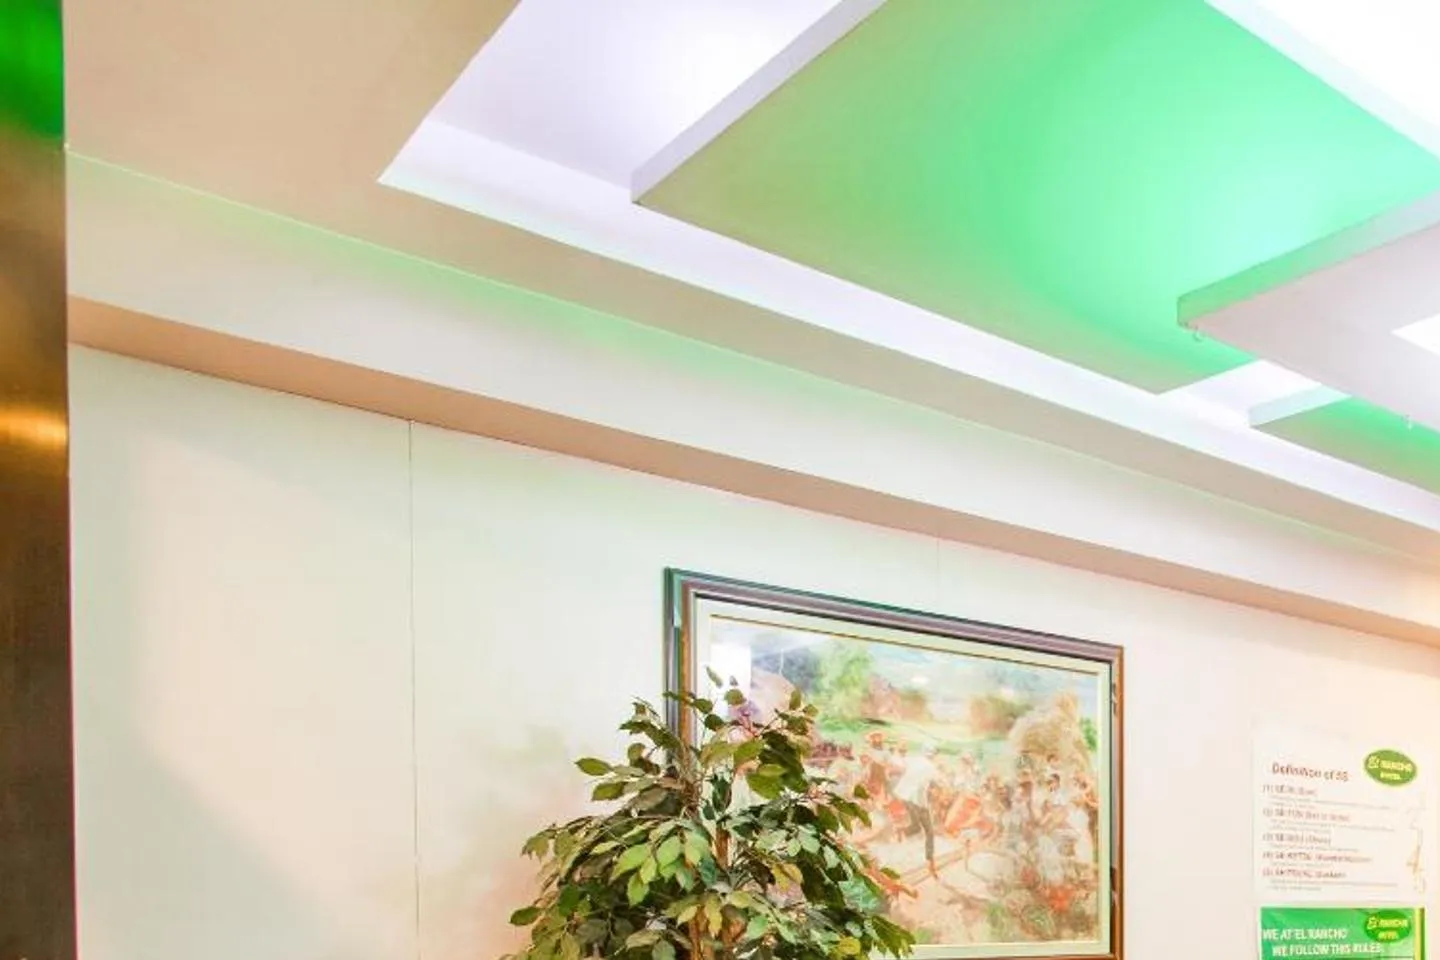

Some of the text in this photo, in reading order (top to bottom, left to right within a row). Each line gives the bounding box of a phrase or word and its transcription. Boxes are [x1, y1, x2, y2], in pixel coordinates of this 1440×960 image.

[1272, 762, 1321, 779] Definition
[1323, 770, 1334, 780] of
[1262, 928, 1348, 940] WE AT EL RANCHO
[1272, 945, 1288, 956] WE
[1289, 945, 1330, 955] FOLLOW
[1330, 944, 1351, 955] THIS
